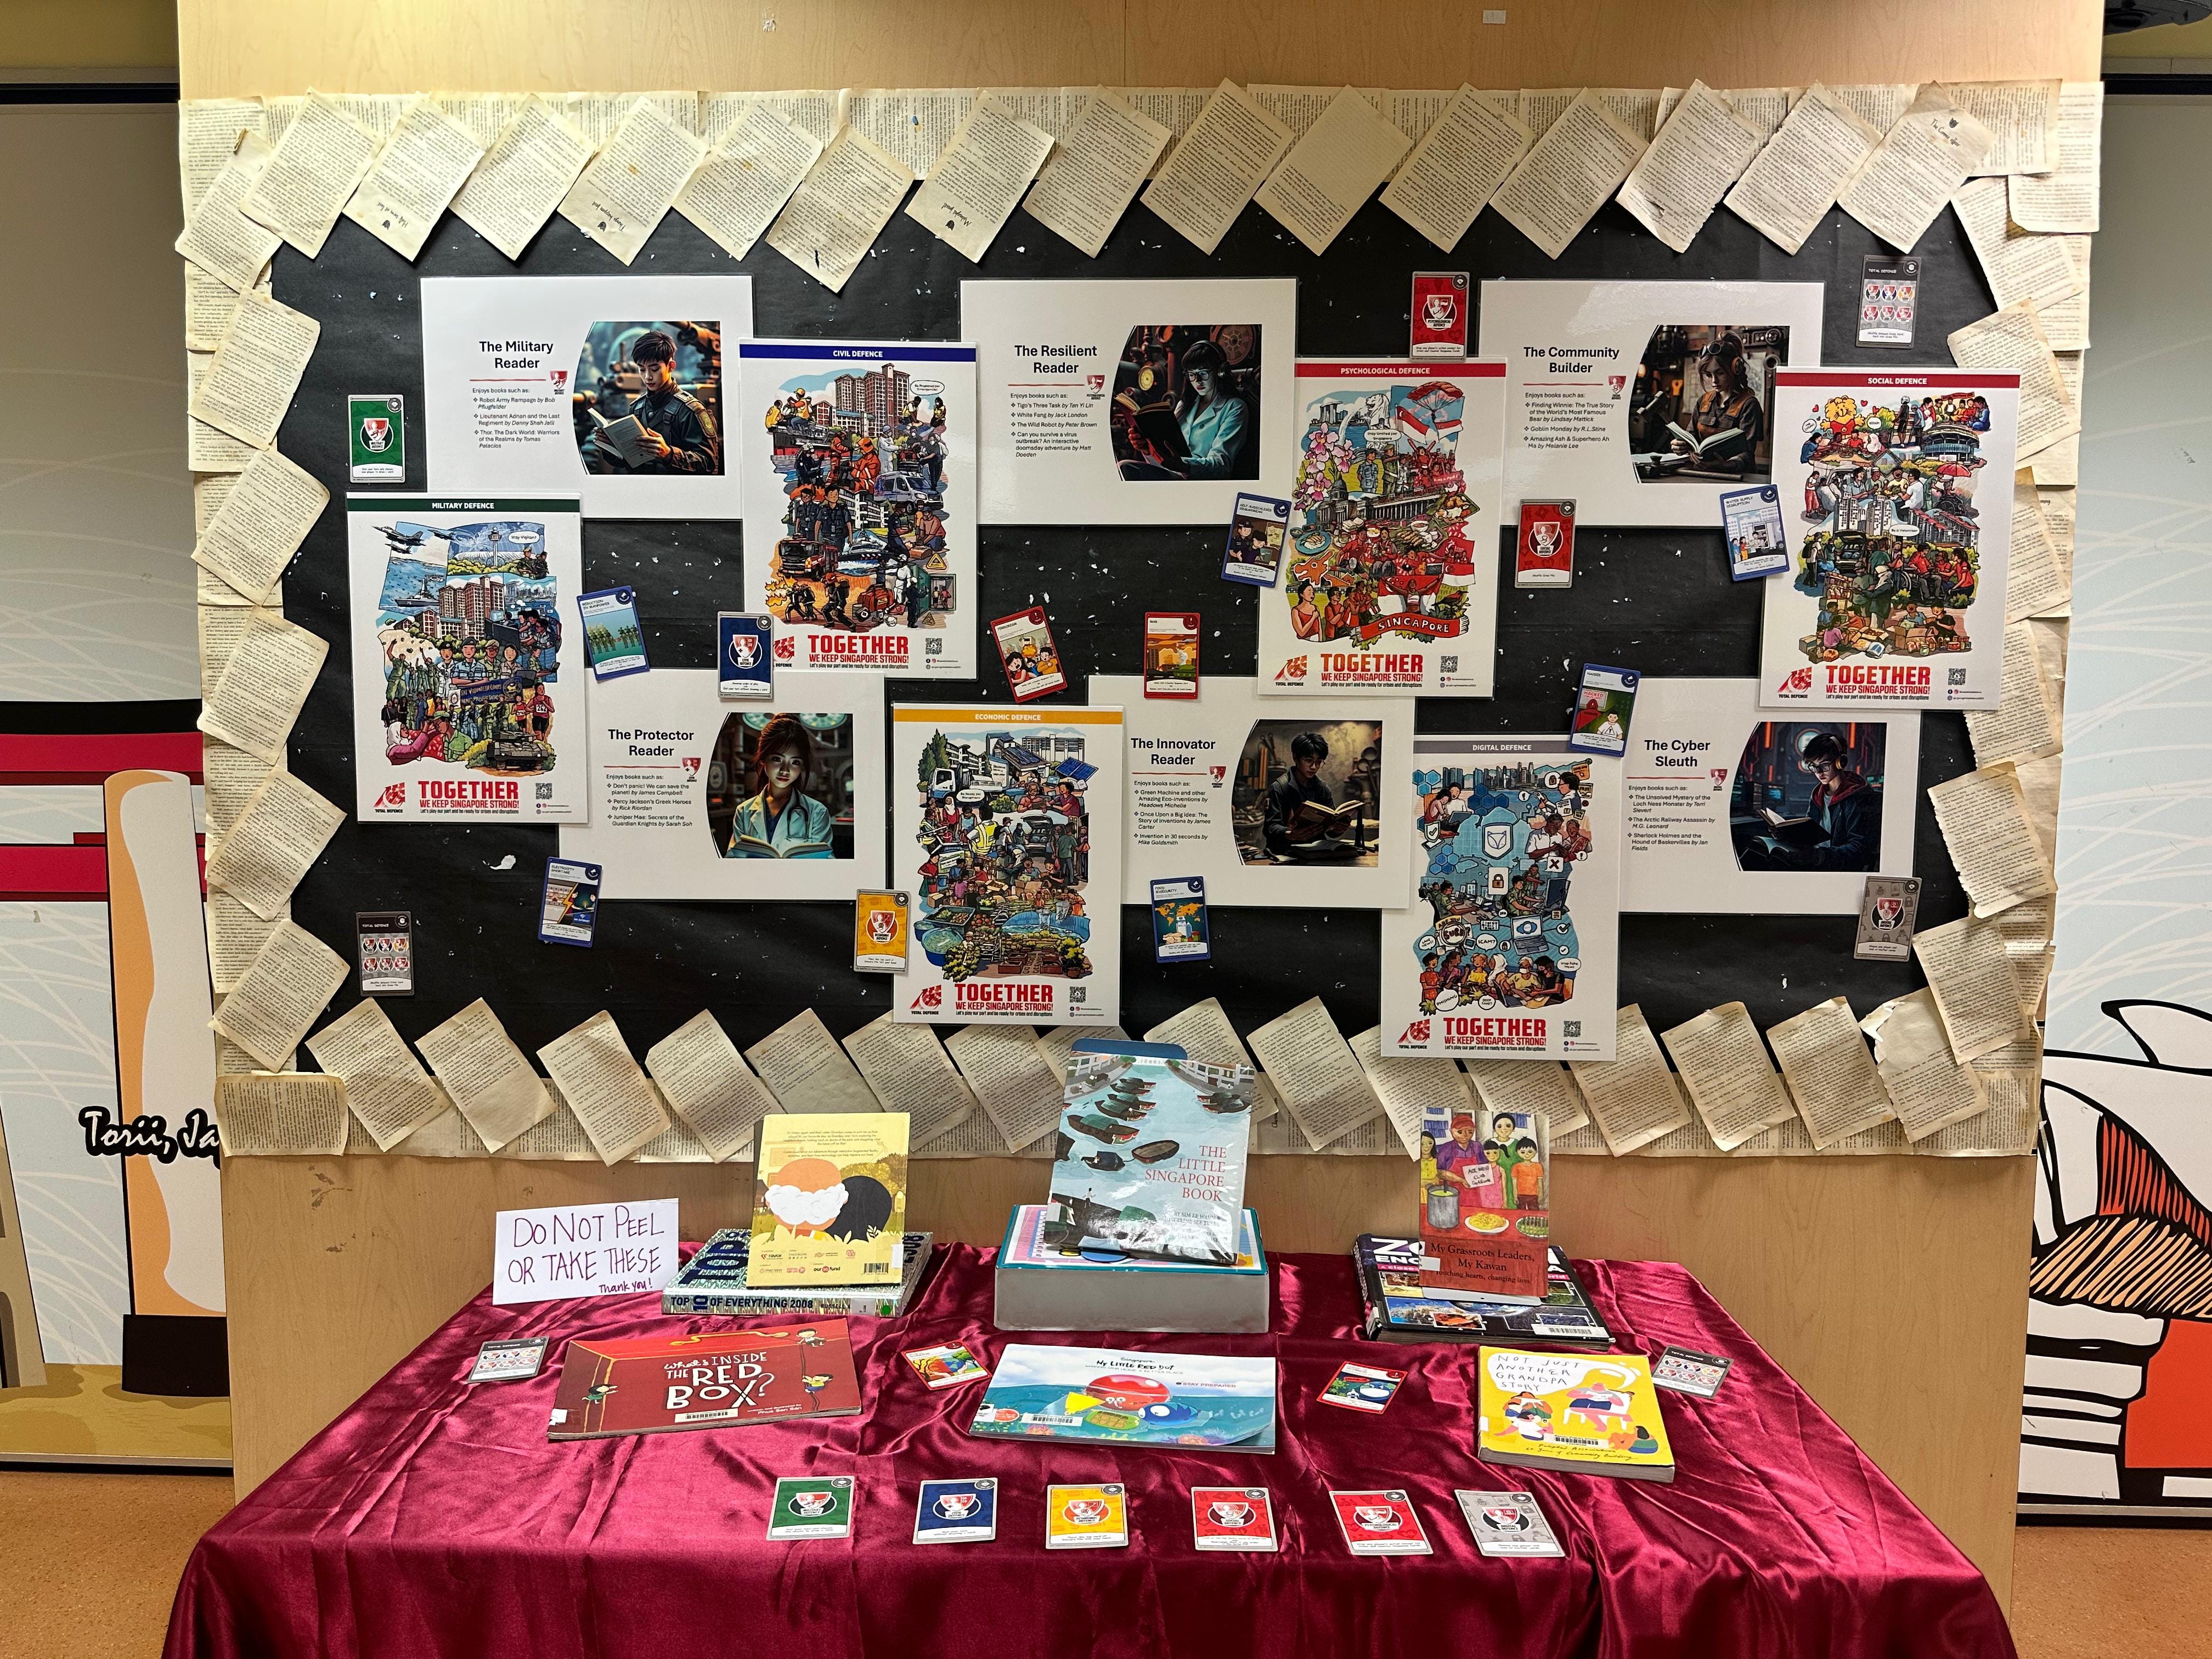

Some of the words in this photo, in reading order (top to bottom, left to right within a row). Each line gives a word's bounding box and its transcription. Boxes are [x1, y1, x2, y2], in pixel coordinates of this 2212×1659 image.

[479, 341, 502, 352] The
[506, 341, 554, 354] Military
[1014, 345, 1038, 357] The
[1041, 345, 1097, 357] Resilient
[1523, 347, 1545, 357] The
[1548, 347, 1620, 360] Community
[495, 357, 540, 369] Reader
[1034, 362, 1079, 373] Reader
[1549, 362, 1593, 373] Builder
[1378, 615, 1449, 634] SINGAPORE
[808, 635, 909, 654] TOGETHER
[1321, 653, 1423, 672] TOGETHER
[1333, 673, 1351, 681] KEEP
[1825, 665, 1931, 685] TOGETHER
[608, 729, 631, 740] The
[635, 729, 695, 741] Protector
[1131, 738, 1154, 749] The
[1157, 738, 1216, 749] Innovator
[1644, 740, 1668, 751] The
[1671, 740, 1711, 753] Cyber
[629, 745, 674, 756] Reader
[1151, 754, 1195, 765] Reader
[1655, 755, 1697, 767] Sleuth
[417, 781, 518, 799] TOGETHER
[419, 799, 431, 808] WE
[431, 799, 449, 808] KEEP
[450, 800, 489, 808] SINGAPORE
[490, 800, 520, 809] STRONG!
[1443, 927, 1471, 940] SURE?
[954, 984, 1053, 1002] TOGETHER
[1436, 994, 1458, 1006] PHISHING
[1443, 1018, 1546, 1036] TOGETHER
[1444, 1036, 1455, 1044] WE
[1457, 1036, 1475, 1045] KEEP
[1476, 1036, 1515, 1045] SINGAPORE
[1516, 1037, 1547, 1046] STRONG!
[84, 1110, 171, 1154] Torii,
[1199, 1145, 1227, 1158] THE
[1178, 1158, 1226, 1172] LITTLE
[1145, 1169, 1224, 1187] SINGAPORE
[1182, 1187, 1223, 1202] BOOK
[554, 1213, 605, 1245] NOT
[615, 1205, 664, 1238] PEEL
[1431, 1243, 1446, 1253] My
[1448, 1245, 1495, 1258] Grassroots
[1498, 1249, 1534, 1261] Leaders,
[508, 1256, 535, 1285] OR
[542, 1251, 597, 1281] TAKE
[604, 1247, 662, 1274] THESE
[1458, 1258, 1473, 1268] My
[1476, 1260, 1507, 1271] Kawan
[1487, 1274, 1516, 1283] changing
[599, 1280, 630, 1294] Thank
[631, 1278, 653, 1290] you!
[670, 1297, 690, 1306] TOP
[693, 1295, 708, 1311] 10
[710, 1297, 724, 1306] OF
[725, 1298, 787, 1308] EVERYTHING
[790, 1299, 813, 1309] 2008
[711, 1351, 768, 1366] INSIDE
[1498, 1355, 1530, 1364] NOT
[1542, 1360, 1580, 1368] JUST
[666, 1369, 689, 1379] THE
[692, 1363, 762, 1386] RED
[1496, 1363, 1571, 1376] ANOTHER
[1496, 1372, 1567, 1386] GRANDPA
[666, 1373, 775, 1409] BOX?
[1502, 1382, 1540, 1392] STORY
